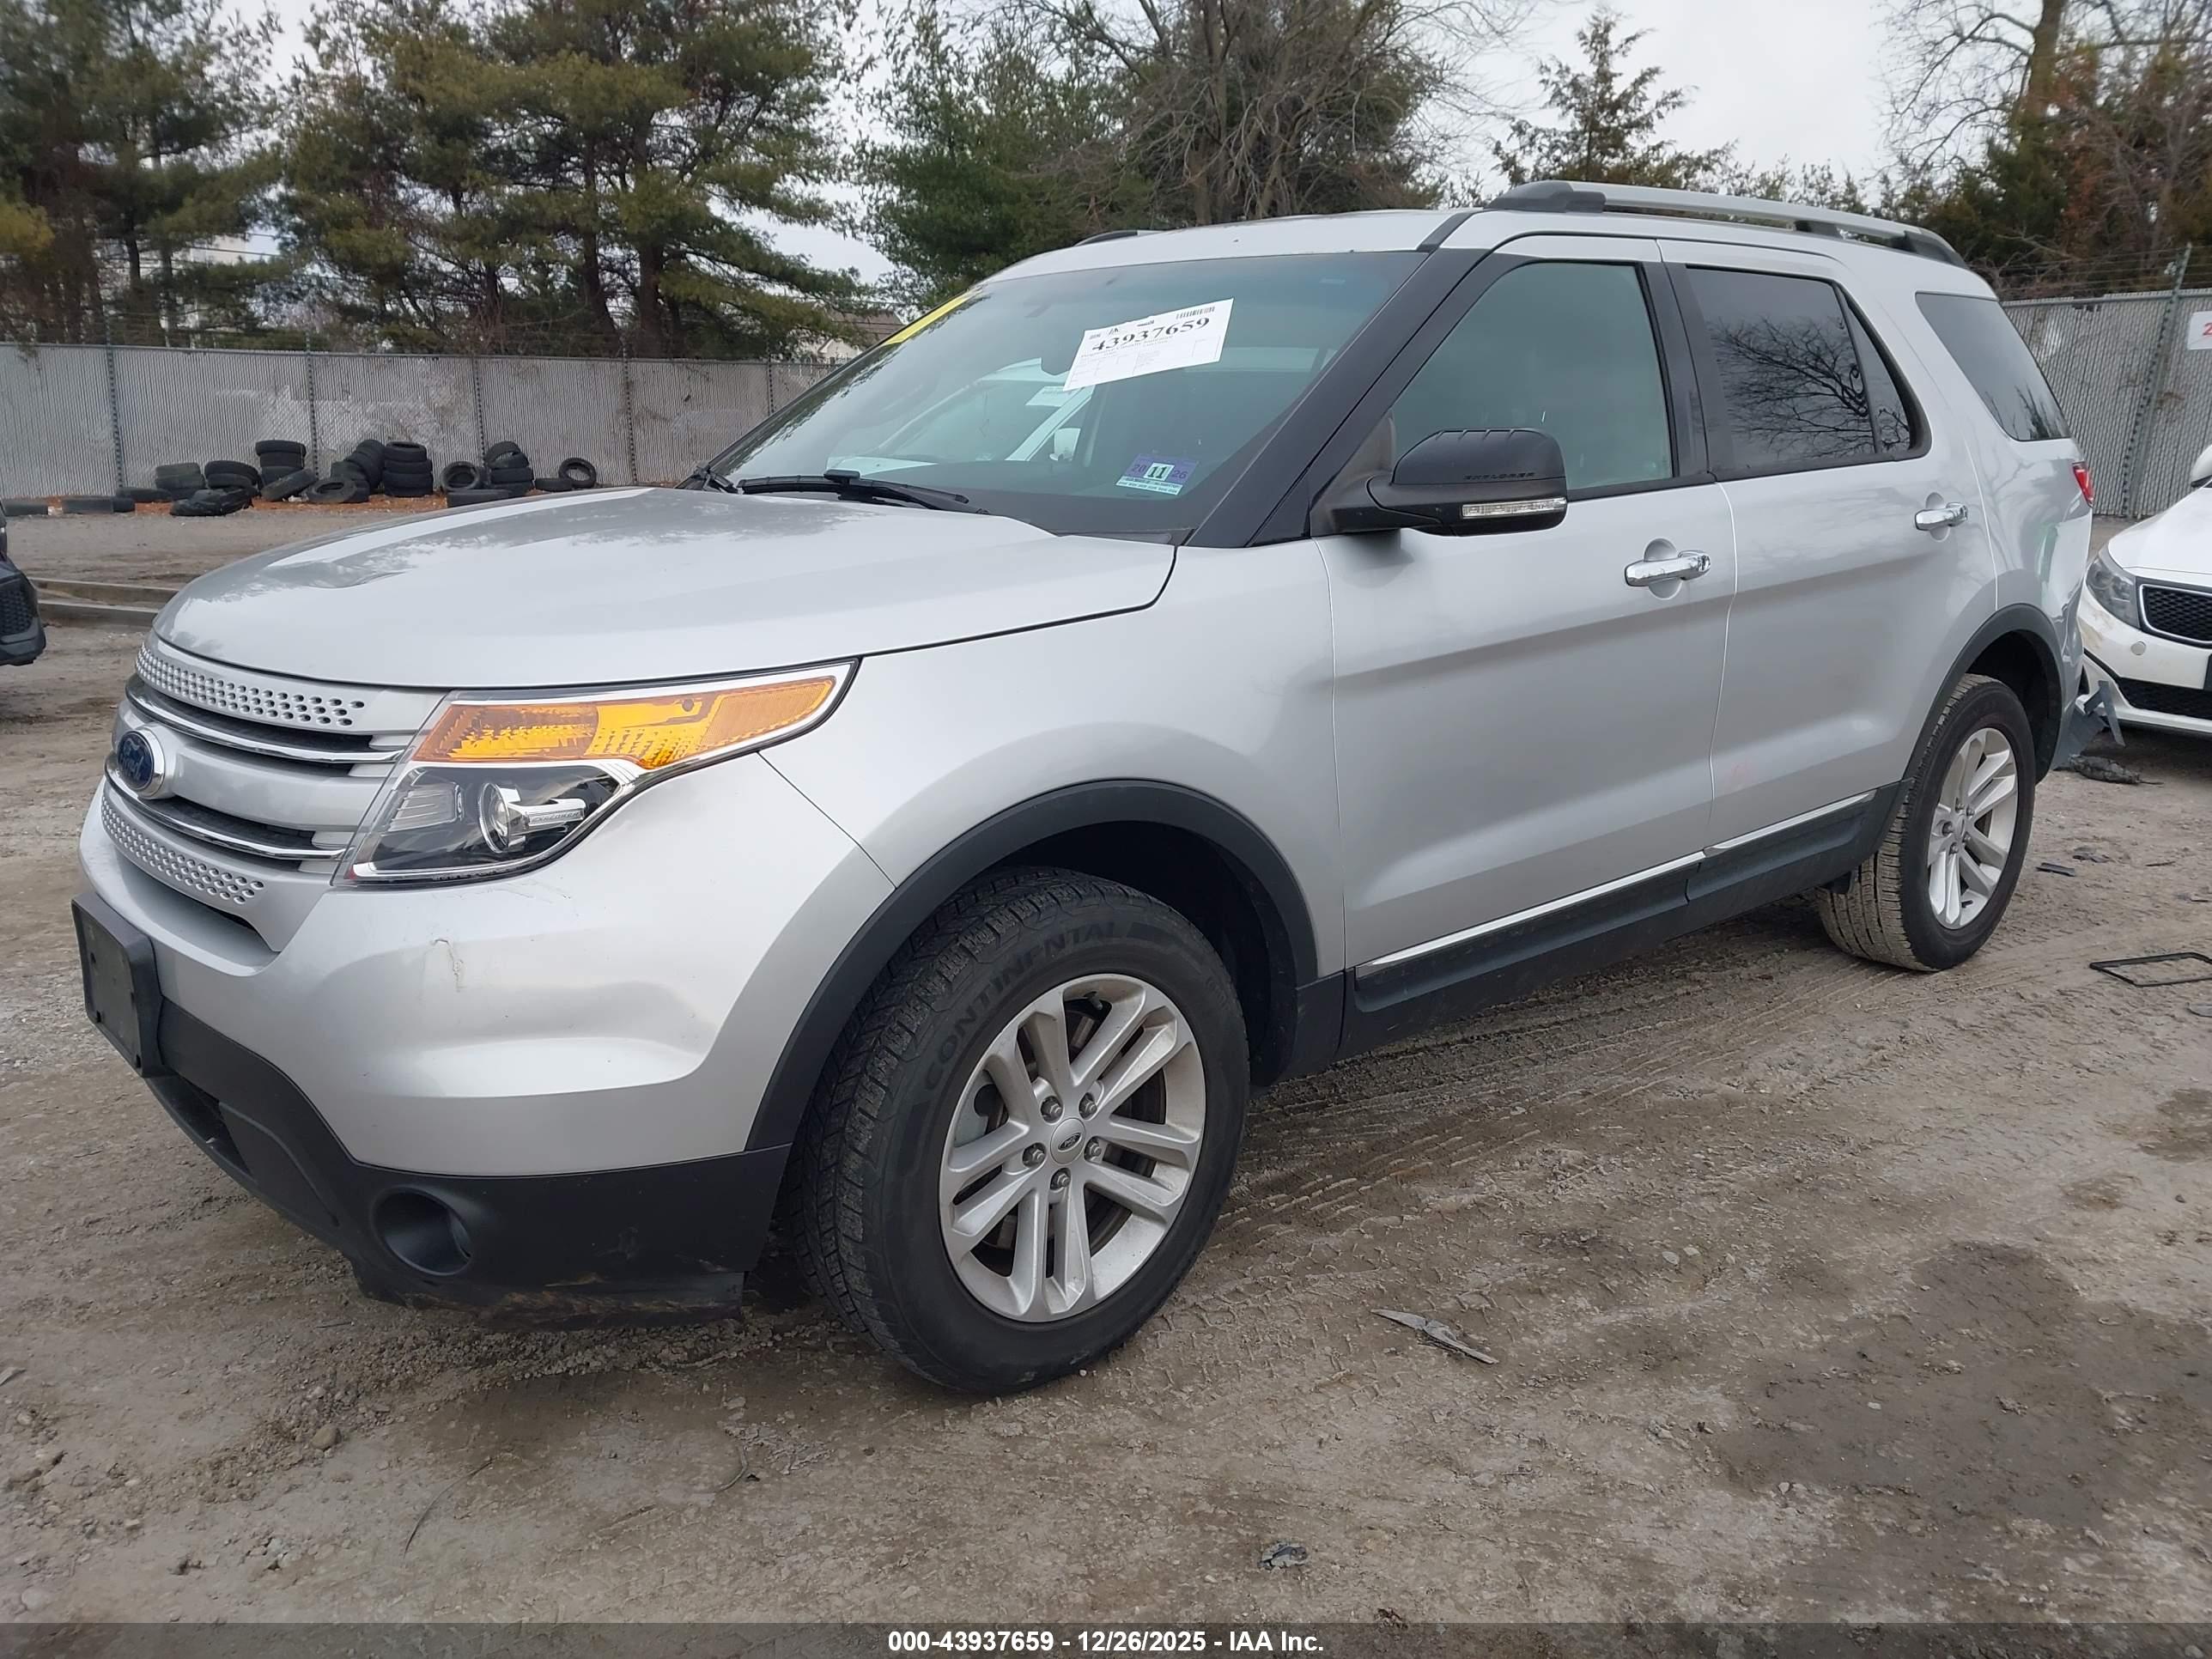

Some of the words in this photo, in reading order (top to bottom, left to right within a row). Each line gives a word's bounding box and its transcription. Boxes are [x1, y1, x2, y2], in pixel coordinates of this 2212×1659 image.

[1092, 317, 1210, 351] 43937659
[1147, 465, 1168, 479] 11
[1171, 470, 1188, 480] 26
[926, 921, 1127, 1091] CONTINENTAL
